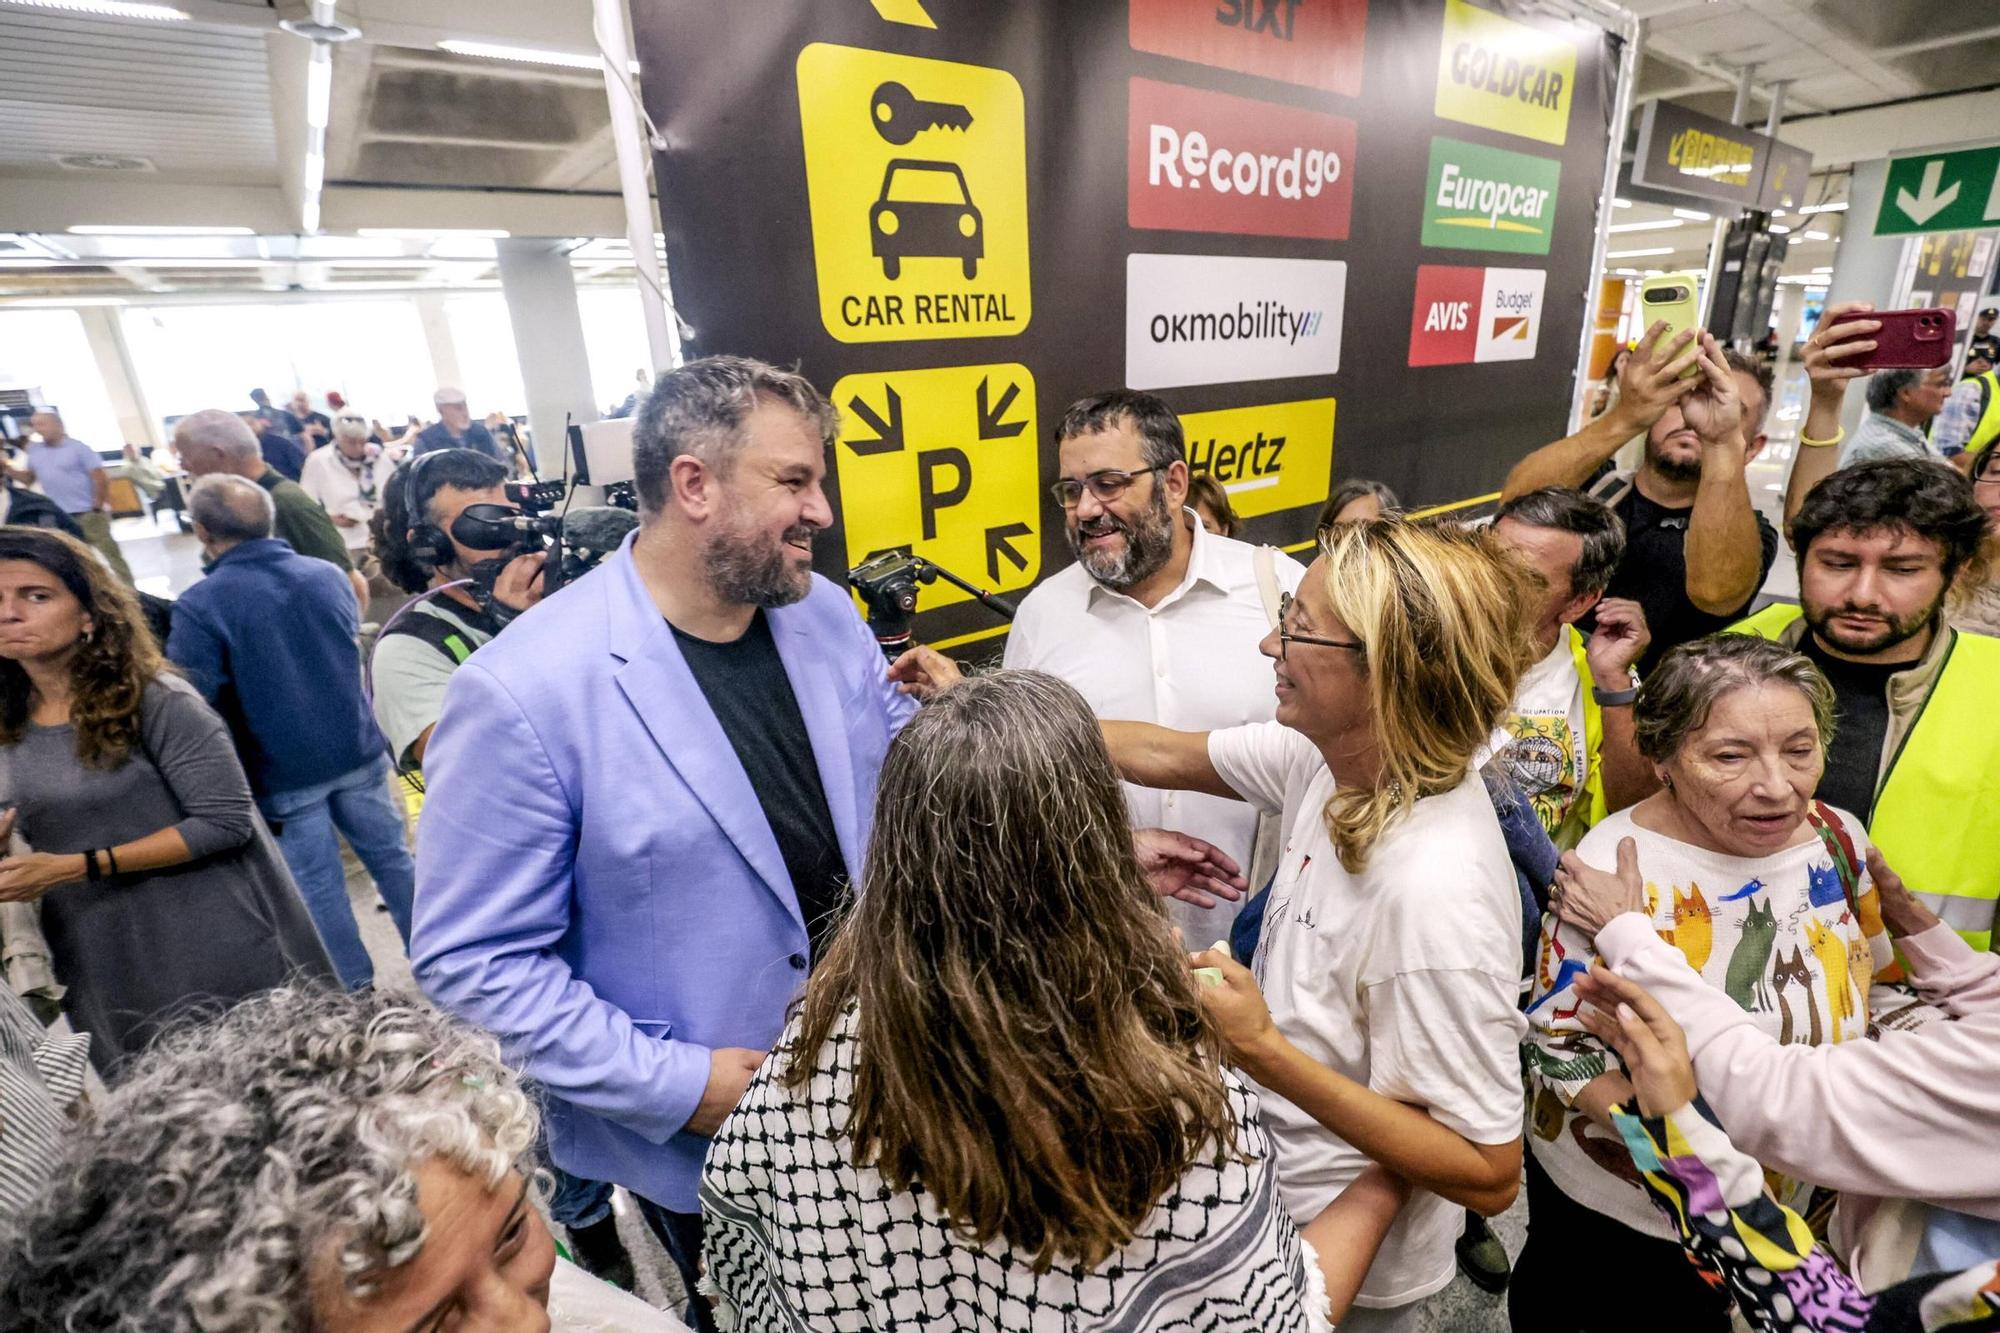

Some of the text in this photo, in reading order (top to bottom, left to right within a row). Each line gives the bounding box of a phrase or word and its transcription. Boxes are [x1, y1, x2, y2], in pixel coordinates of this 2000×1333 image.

[1452, 43, 1563, 111] GOLDCAR
[1436, 163, 1549, 229] Europcar
[841, 293, 1015, 327] CAR RENTAL
[1424, 301, 1469, 331] AVIS
[1496, 289, 1533, 314] Budget
[1188, 432, 1286, 482] Hertz
[917, 447, 972, 541] P
